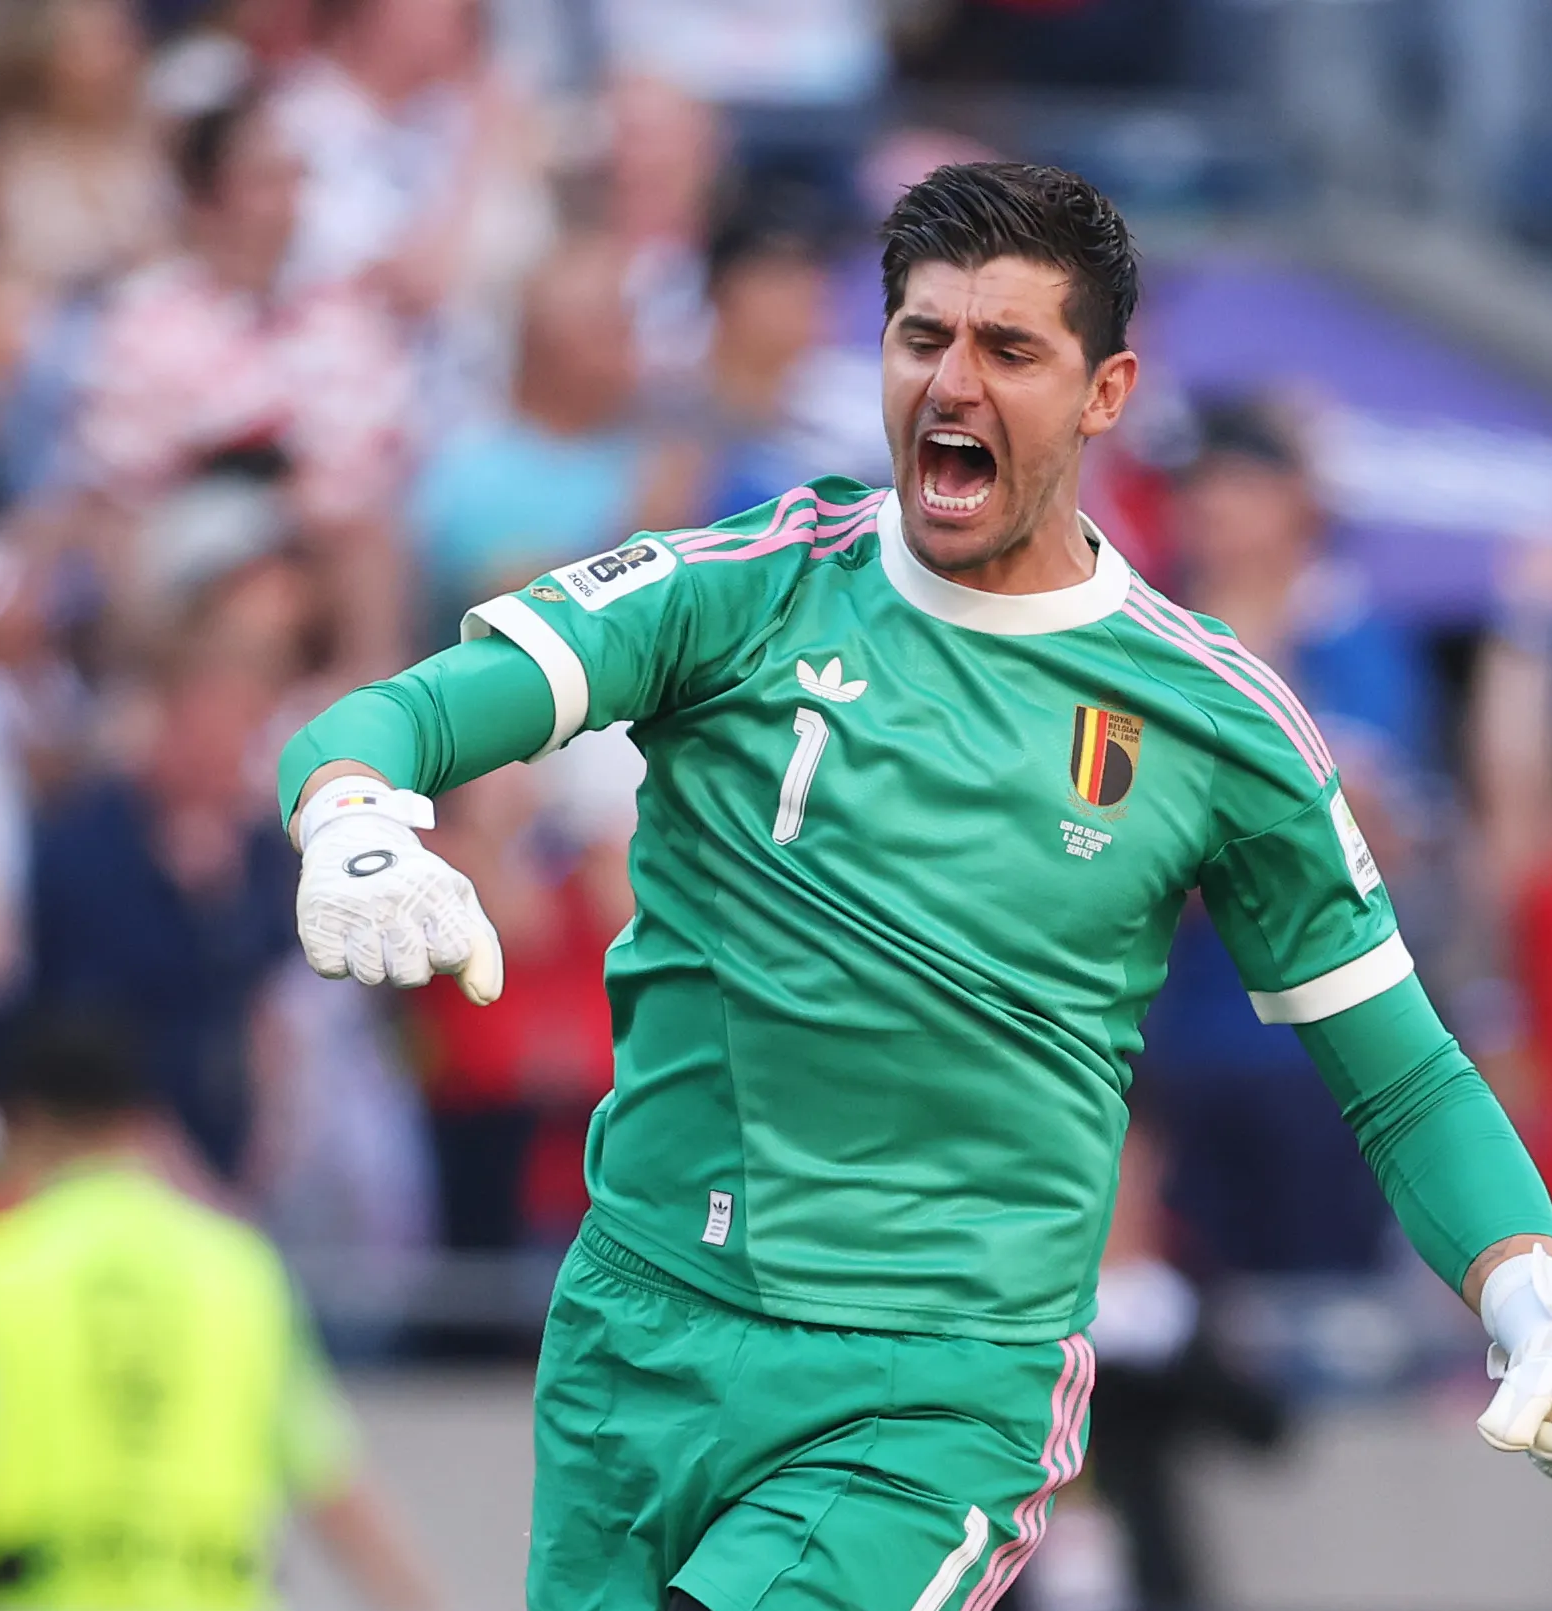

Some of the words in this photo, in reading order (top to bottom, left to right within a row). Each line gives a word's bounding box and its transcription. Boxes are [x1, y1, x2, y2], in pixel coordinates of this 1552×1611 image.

[567, 572, 593, 598] 2026
[1109, 714, 1132, 726] ROYAL
[1108, 730, 1117, 738] FA
[1109, 722, 1140, 736] BELGIAN
[772, 707, 829, 845] 1
[1060, 820, 1075, 832] USA
[1074, 825, 1084, 835] VS
[1084, 827, 1112, 845] BELGIUM
[1062, 832, 1069, 841] 6
[1069, 834, 1086, 846] JULY
[1065, 843, 1094, 860] SEATTLE
